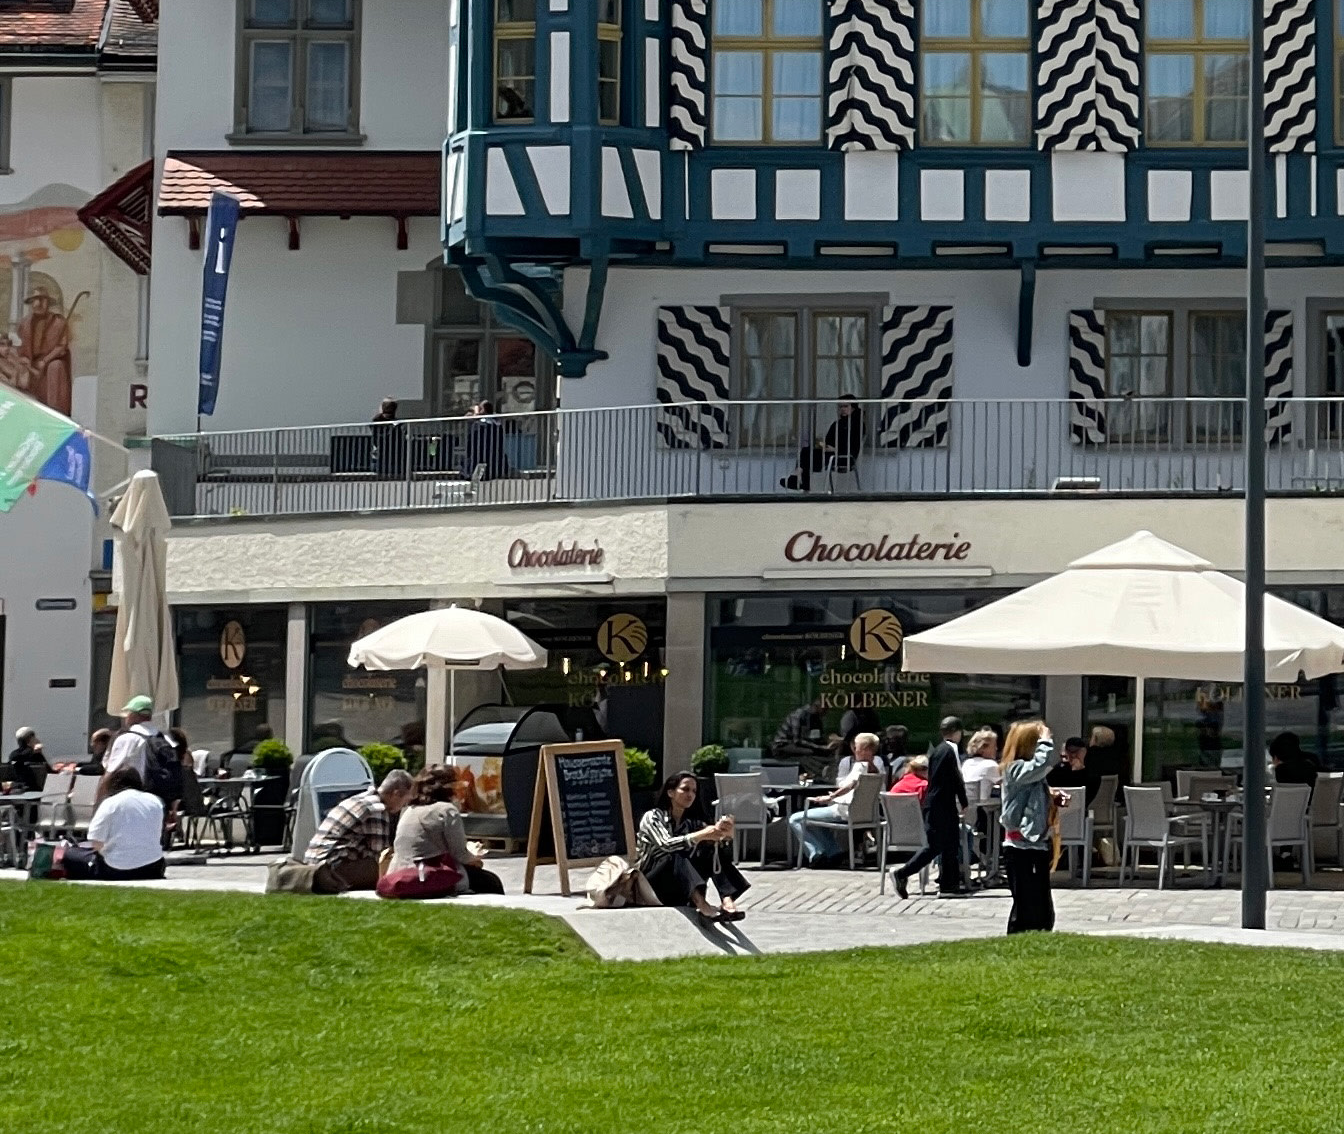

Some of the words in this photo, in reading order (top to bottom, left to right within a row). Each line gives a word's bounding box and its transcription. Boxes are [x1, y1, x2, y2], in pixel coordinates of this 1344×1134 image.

[507, 538, 605, 568] Chocolaterie
[784, 530, 972, 563] Chocolaterie
[858, 616, 895, 653] K
[819, 668, 931, 686] chocolaterie
[819, 689, 928, 709] KÖLBENER
